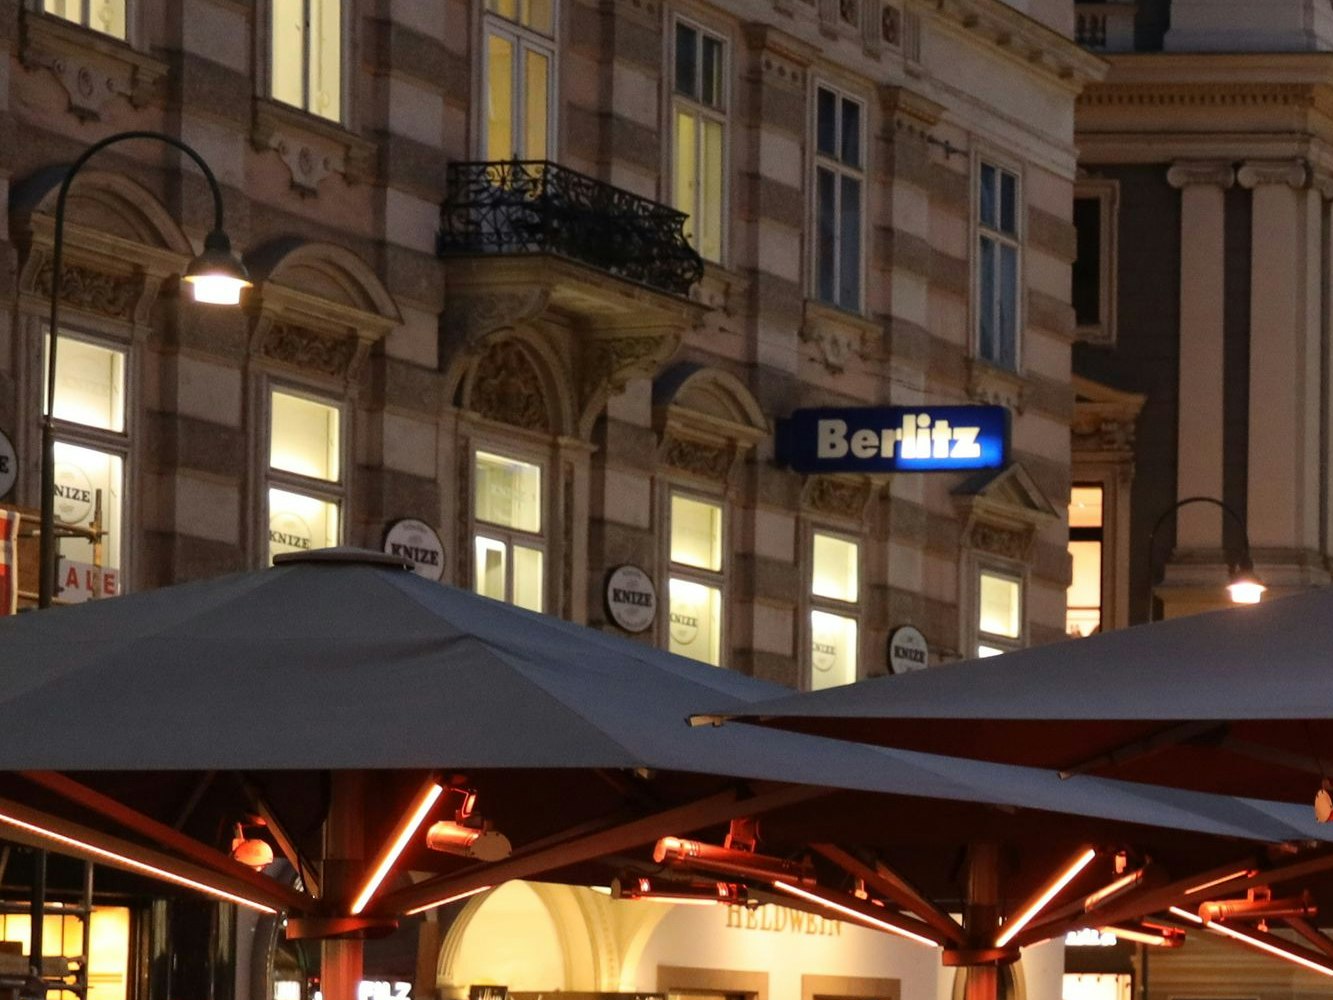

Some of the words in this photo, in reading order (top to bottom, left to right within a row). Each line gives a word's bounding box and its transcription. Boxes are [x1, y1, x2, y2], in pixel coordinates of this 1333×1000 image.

[817, 413, 981, 459] Berlitz
[53, 484, 91, 503] NIZE
[391, 543, 439, 566] KNIZE
[612, 588, 652, 607] KNIZE
[894, 645, 925, 664] KNIZE
